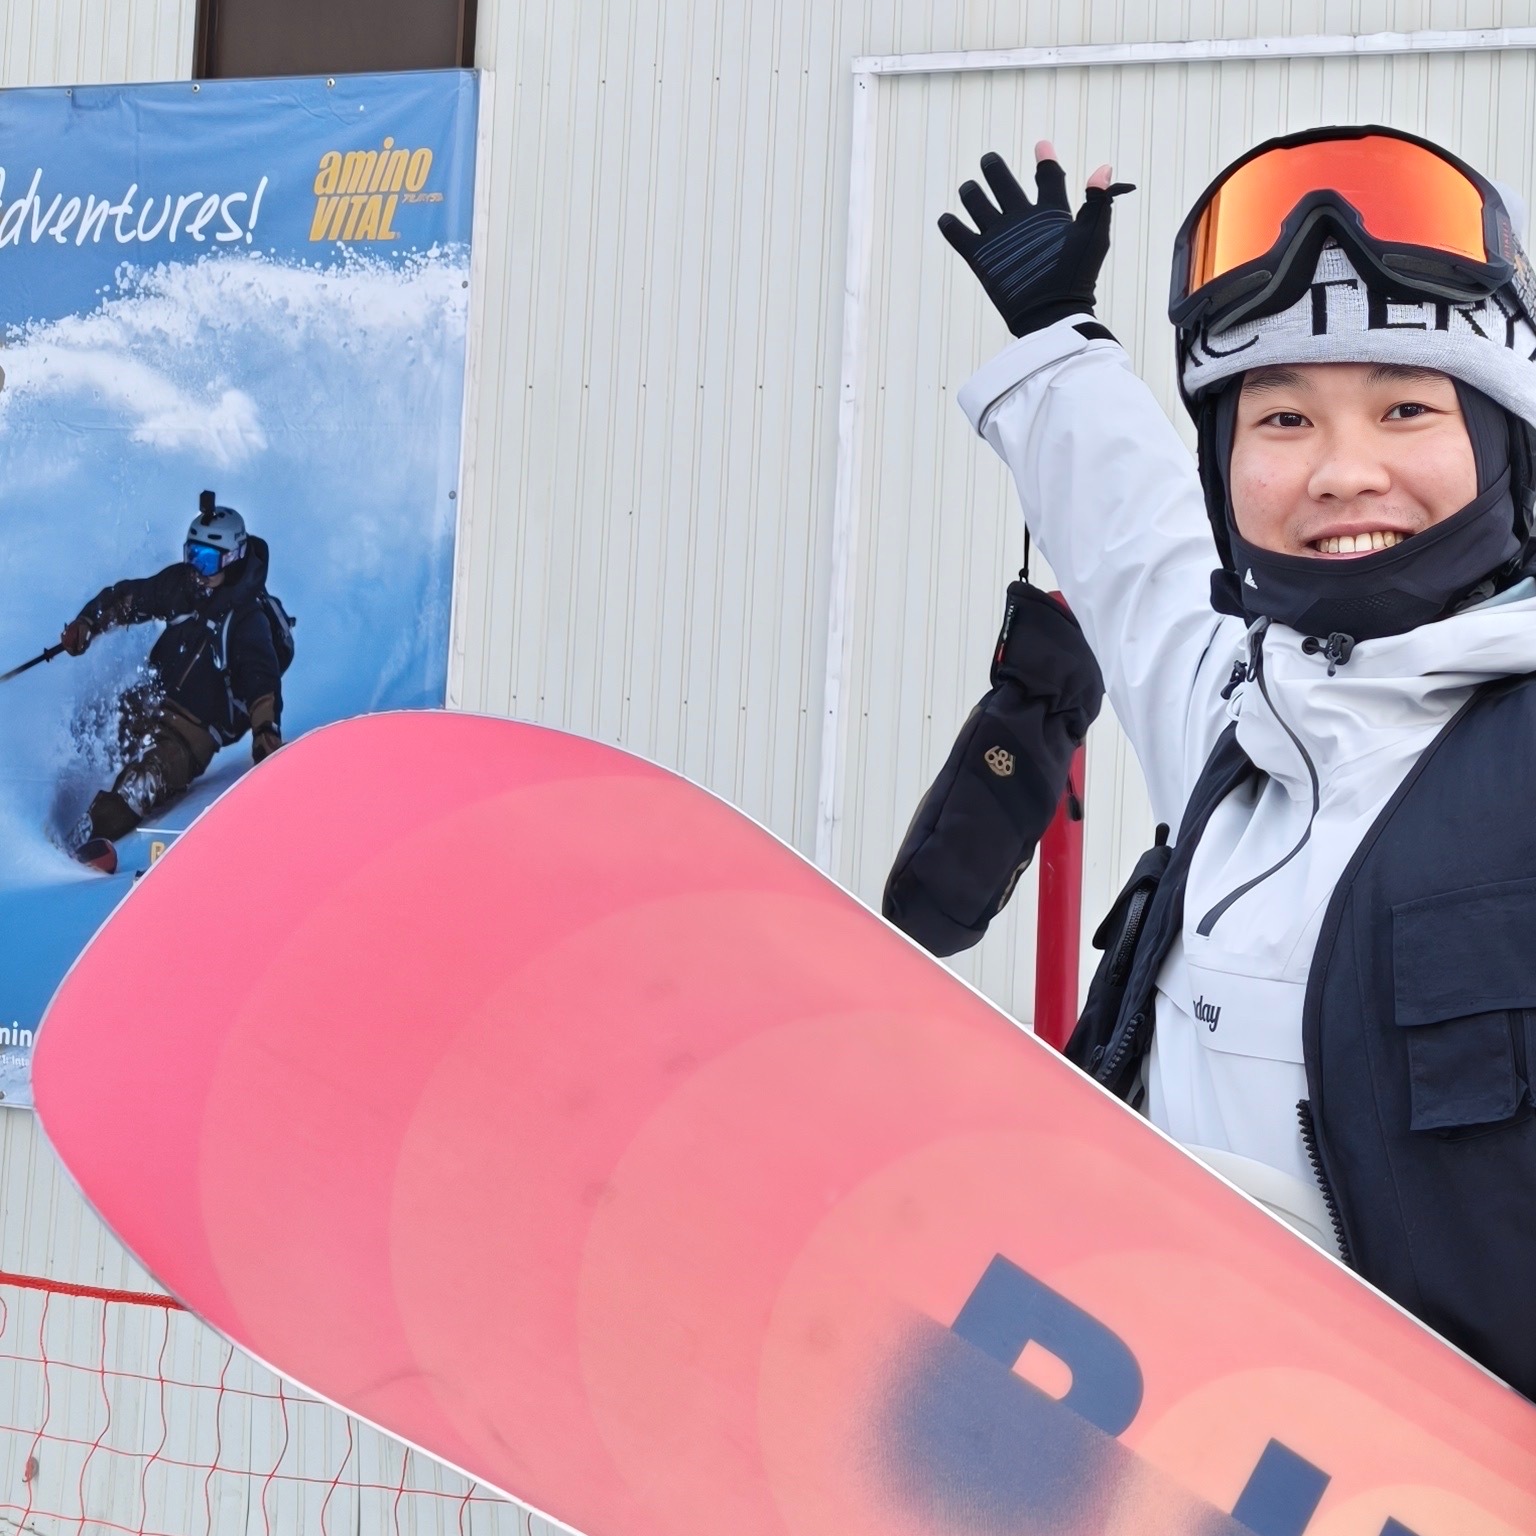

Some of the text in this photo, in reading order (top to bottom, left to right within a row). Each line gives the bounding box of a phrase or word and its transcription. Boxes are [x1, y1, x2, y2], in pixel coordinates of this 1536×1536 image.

[313, 136, 433, 196] amino
[0, 166, 268, 249] dventures!
[309, 194, 399, 241] VITAL
